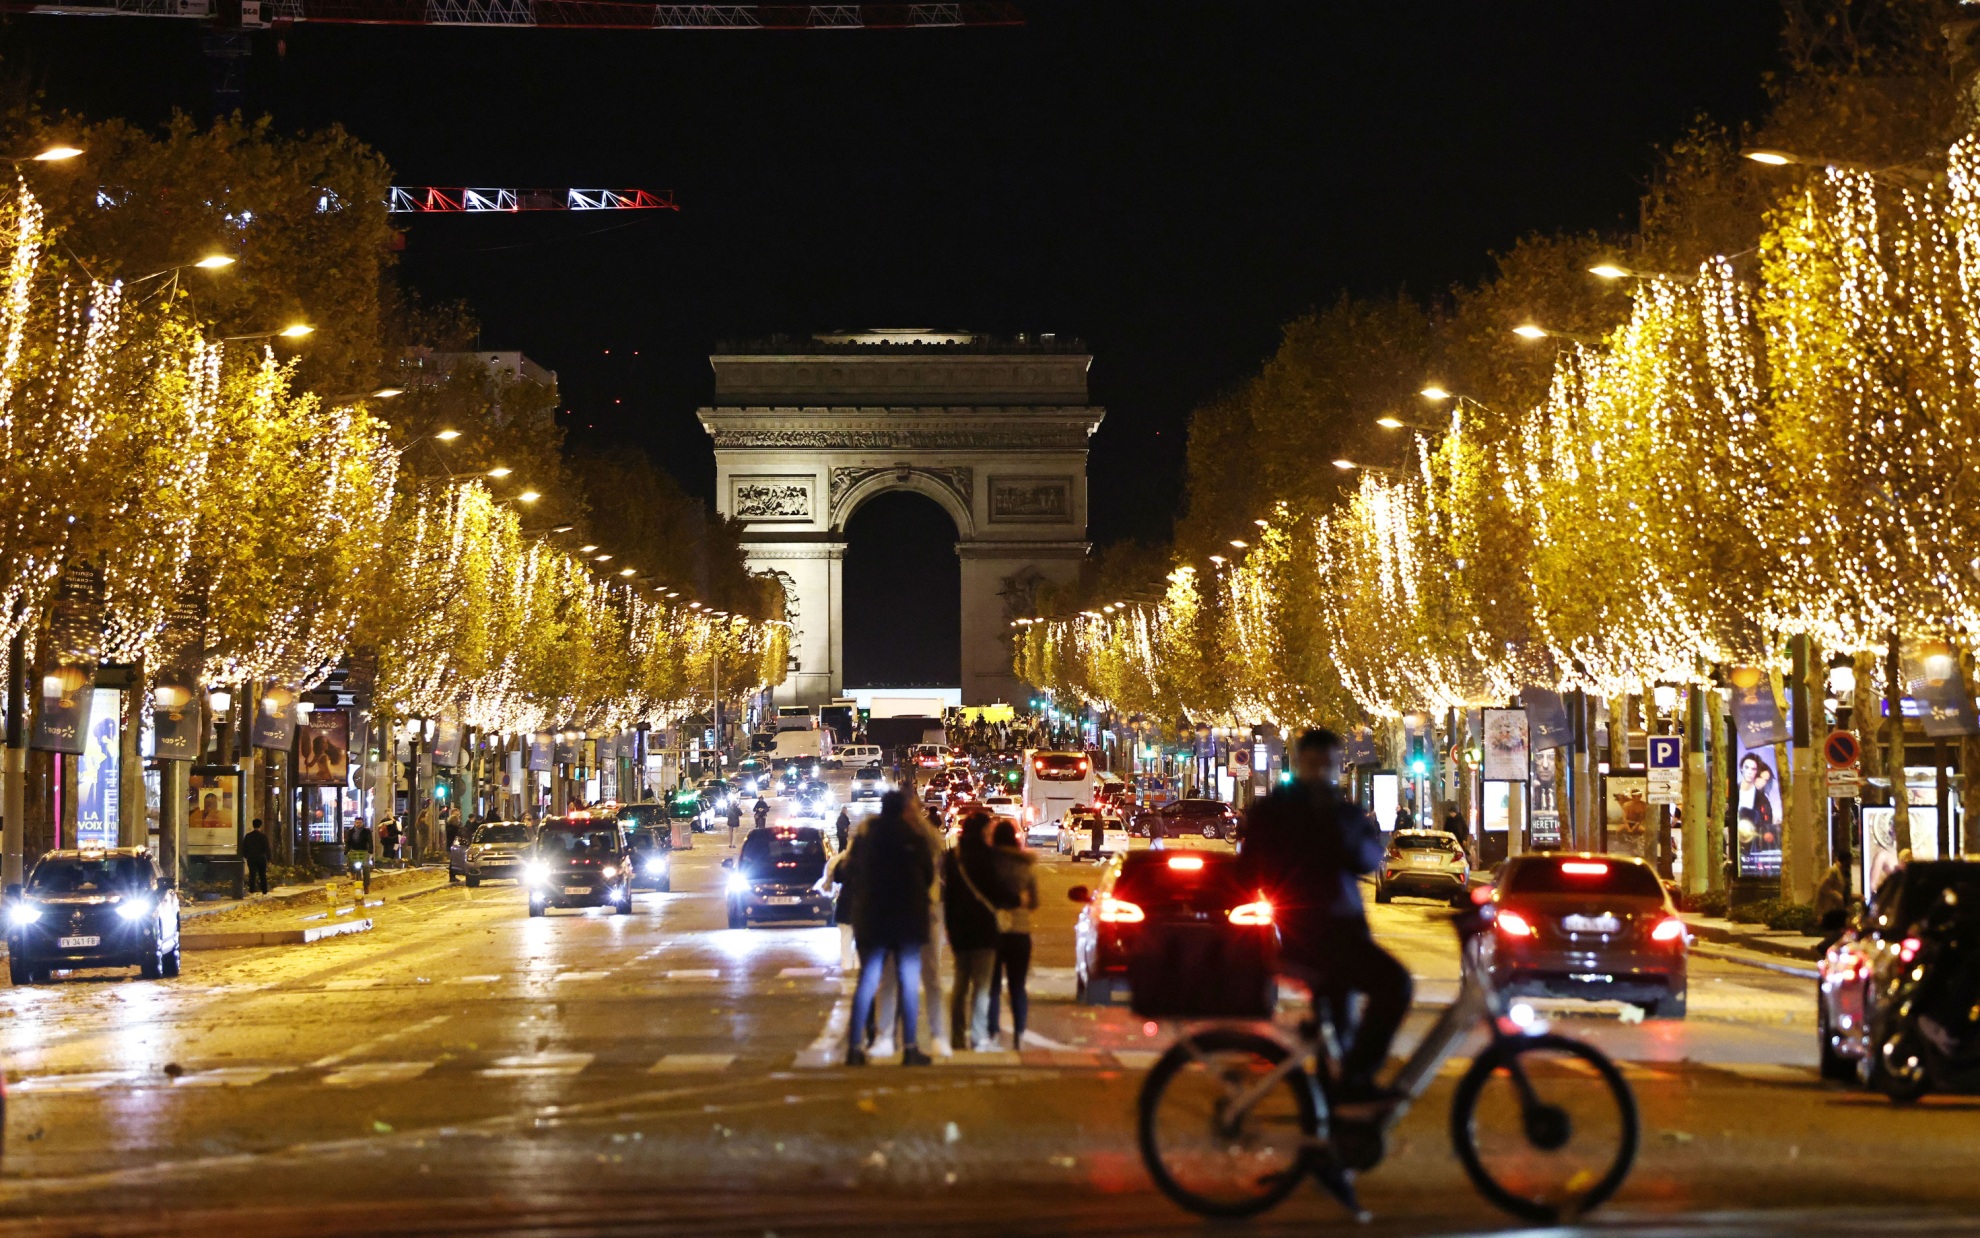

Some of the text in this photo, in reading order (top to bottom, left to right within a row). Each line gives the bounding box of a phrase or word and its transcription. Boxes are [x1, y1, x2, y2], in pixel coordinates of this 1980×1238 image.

[1657, 742, 1672, 764] P
[83, 811, 99, 821] LA
[77, 821, 103, 831] VOIX
